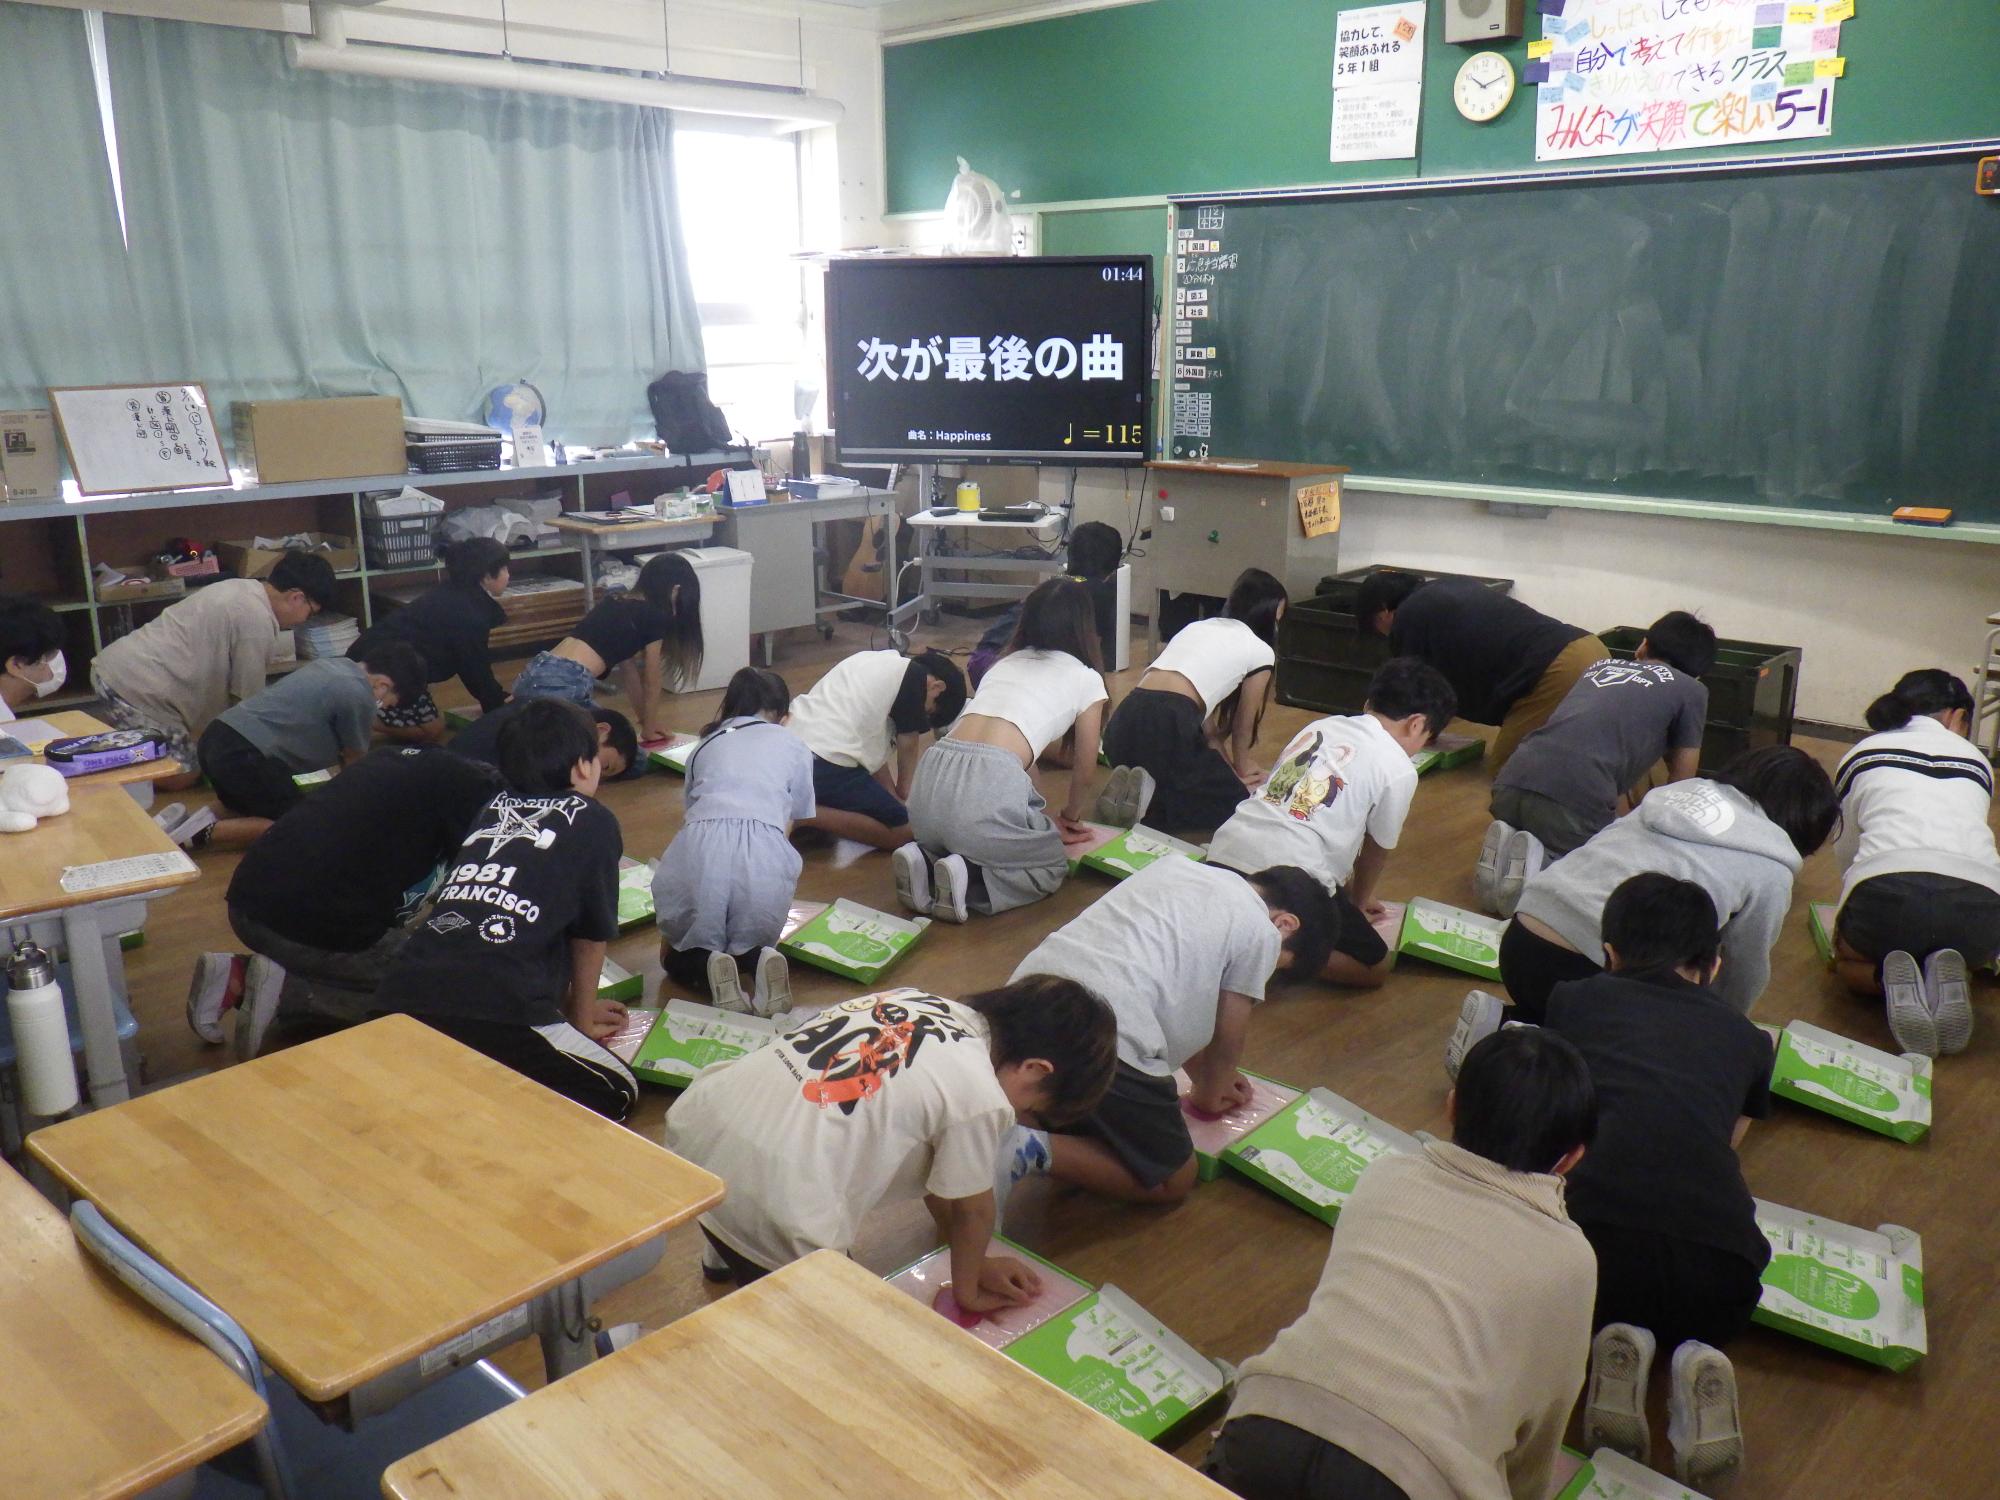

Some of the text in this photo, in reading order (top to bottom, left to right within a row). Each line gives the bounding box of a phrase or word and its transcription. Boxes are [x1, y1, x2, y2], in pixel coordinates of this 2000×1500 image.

[1338, 40, 1401, 59] 笑顔あふれる
[1337, 59, 1379, 75] 5年1組
[1102, 267, 1143, 281] 01:44
[1190, 308, 1204, 316] 社会
[856, 333, 1124, 382] 次が最後の曲
[1185, 368, 1204, 377] 外国語
[1598, 671, 1628, 683] 7
[1694, 784, 1723, 804] THE
[446, 863, 518, 887] 1981
[437, 885, 540, 923] FRANCISCO
